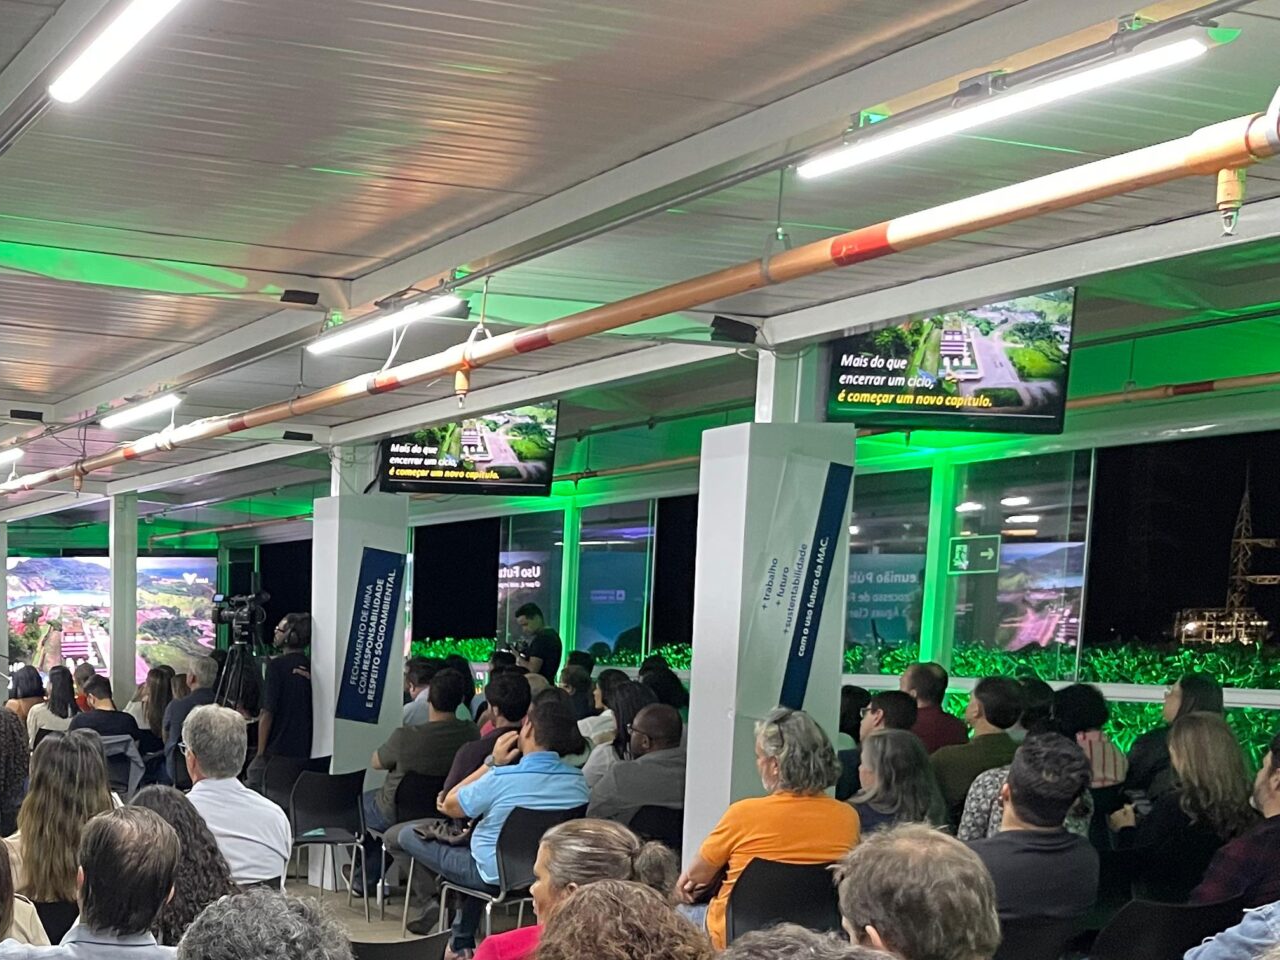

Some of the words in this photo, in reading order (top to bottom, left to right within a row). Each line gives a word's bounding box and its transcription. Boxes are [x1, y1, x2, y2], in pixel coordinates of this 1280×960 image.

[841, 354, 869, 368] Mais
[870, 355, 885, 369] do
[886, 359, 907, 371] que
[839, 374, 886, 386] encerrar
[888, 376, 906, 386] um
[907, 376, 934, 389] ciclo,
[838, 390, 846, 402] é
[847, 392, 895, 405] começar
[896, 395, 914, 404] um
[916, 396, 944, 406] novo
[945, 395, 992, 409] capítulo.
[390, 443, 410, 454] Mais
[411, 444, 422, 454] do
[423, 446, 438, 455] que
[389, 456, 423, 466] encerrar
[424, 458, 437, 466] um
[438, 458, 457, 467] ciclo,
[389, 467, 395, 476] é
[396, 468, 429, 478] começar
[430, 469, 443, 477] um
[444, 470, 464, 478] novo
[465, 470, 499, 480] capítulo.
[816, 536, 829, 563] MAC.
[763, 558, 778, 601] trabalho
[814, 564, 822, 577] da
[777, 566, 789, 597] futuro
[807, 578, 819, 608] futuro
[362, 578, 384, 670] RESPONSABILIDADE
[804, 609, 813, 627] uso
[350, 622, 367, 685] FECHAMENTO
[360, 608, 369, 622] DE
[365, 584, 373, 608] MINA
[798, 636, 807, 657] com
[358, 671, 368, 694] COM
[368, 657, 381, 700] RESPEITO
